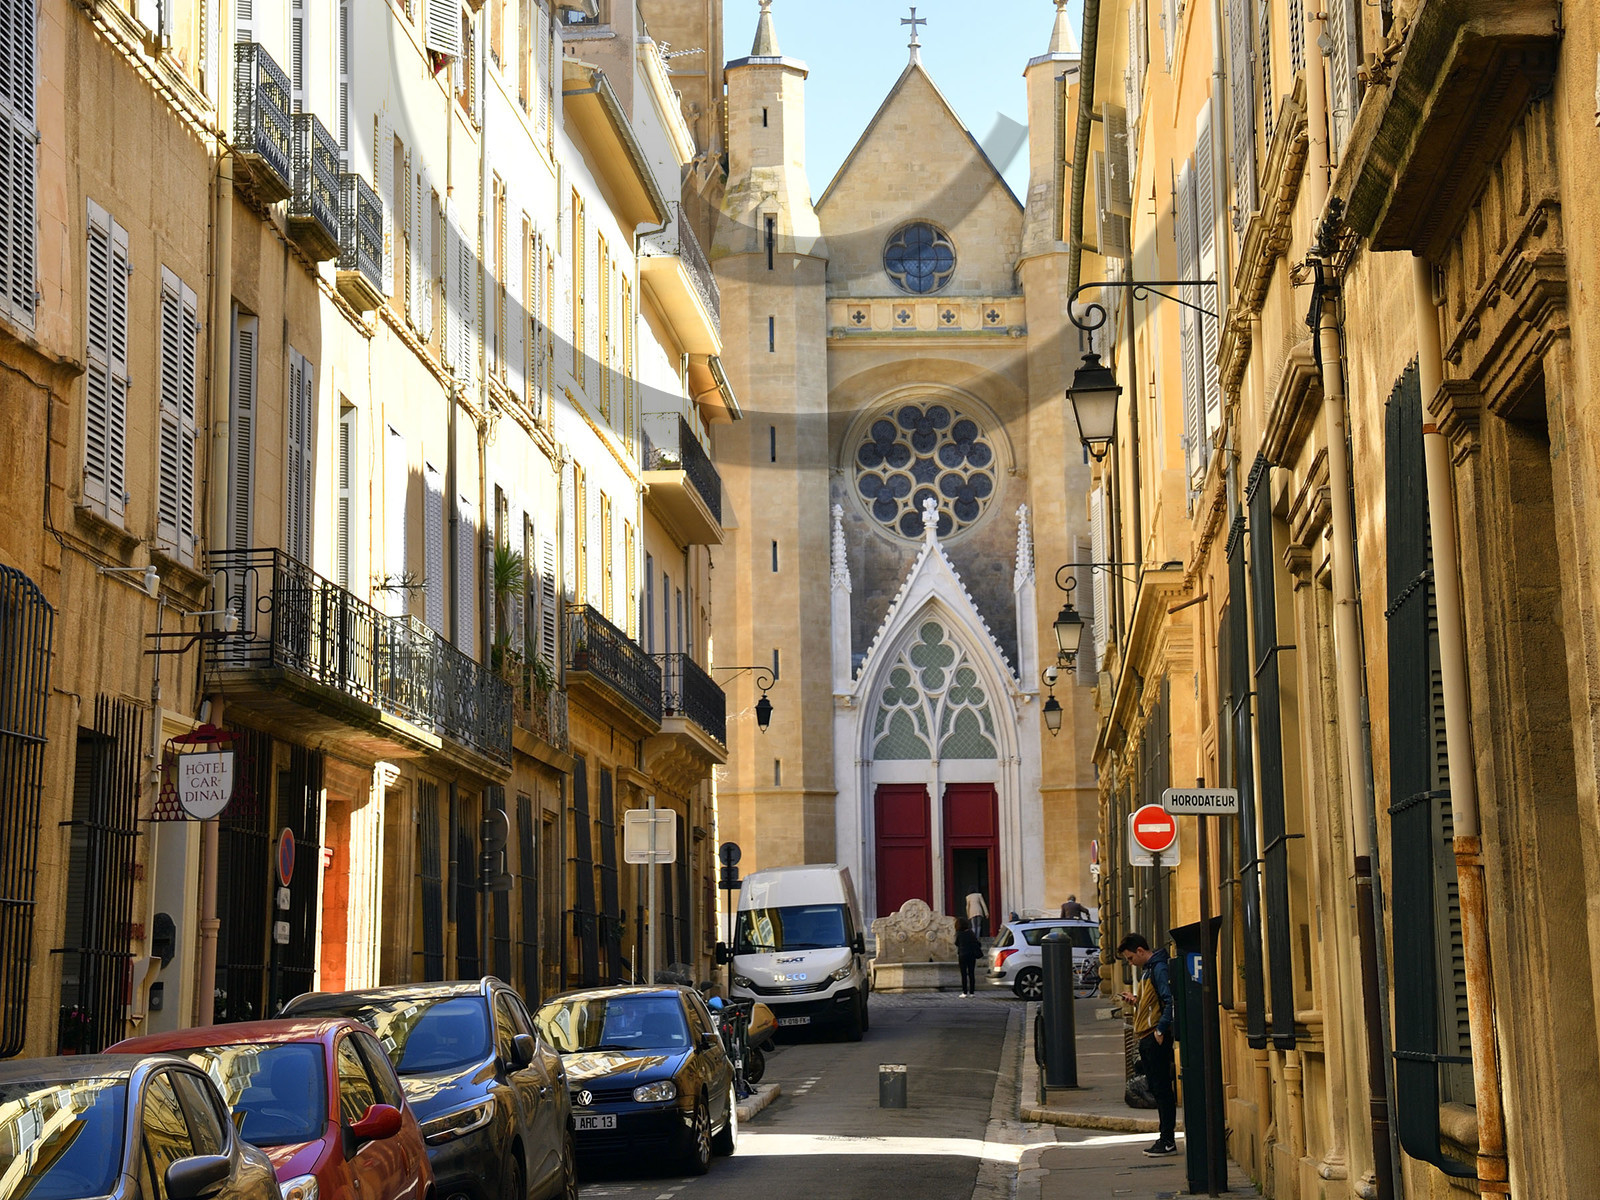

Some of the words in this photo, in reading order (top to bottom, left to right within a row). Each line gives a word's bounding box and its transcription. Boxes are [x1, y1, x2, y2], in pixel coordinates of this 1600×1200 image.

[186, 761, 227, 775] HÔTEL
[190, 776, 221, 788] CAR-
[185, 789, 227, 802] DINAL
[1171, 795, 1235, 807] HORODATEUR
[774, 972, 807, 982] IVECO
[580, 1116, 598, 1129] ARC
[601, 1116, 613, 1128] 13
